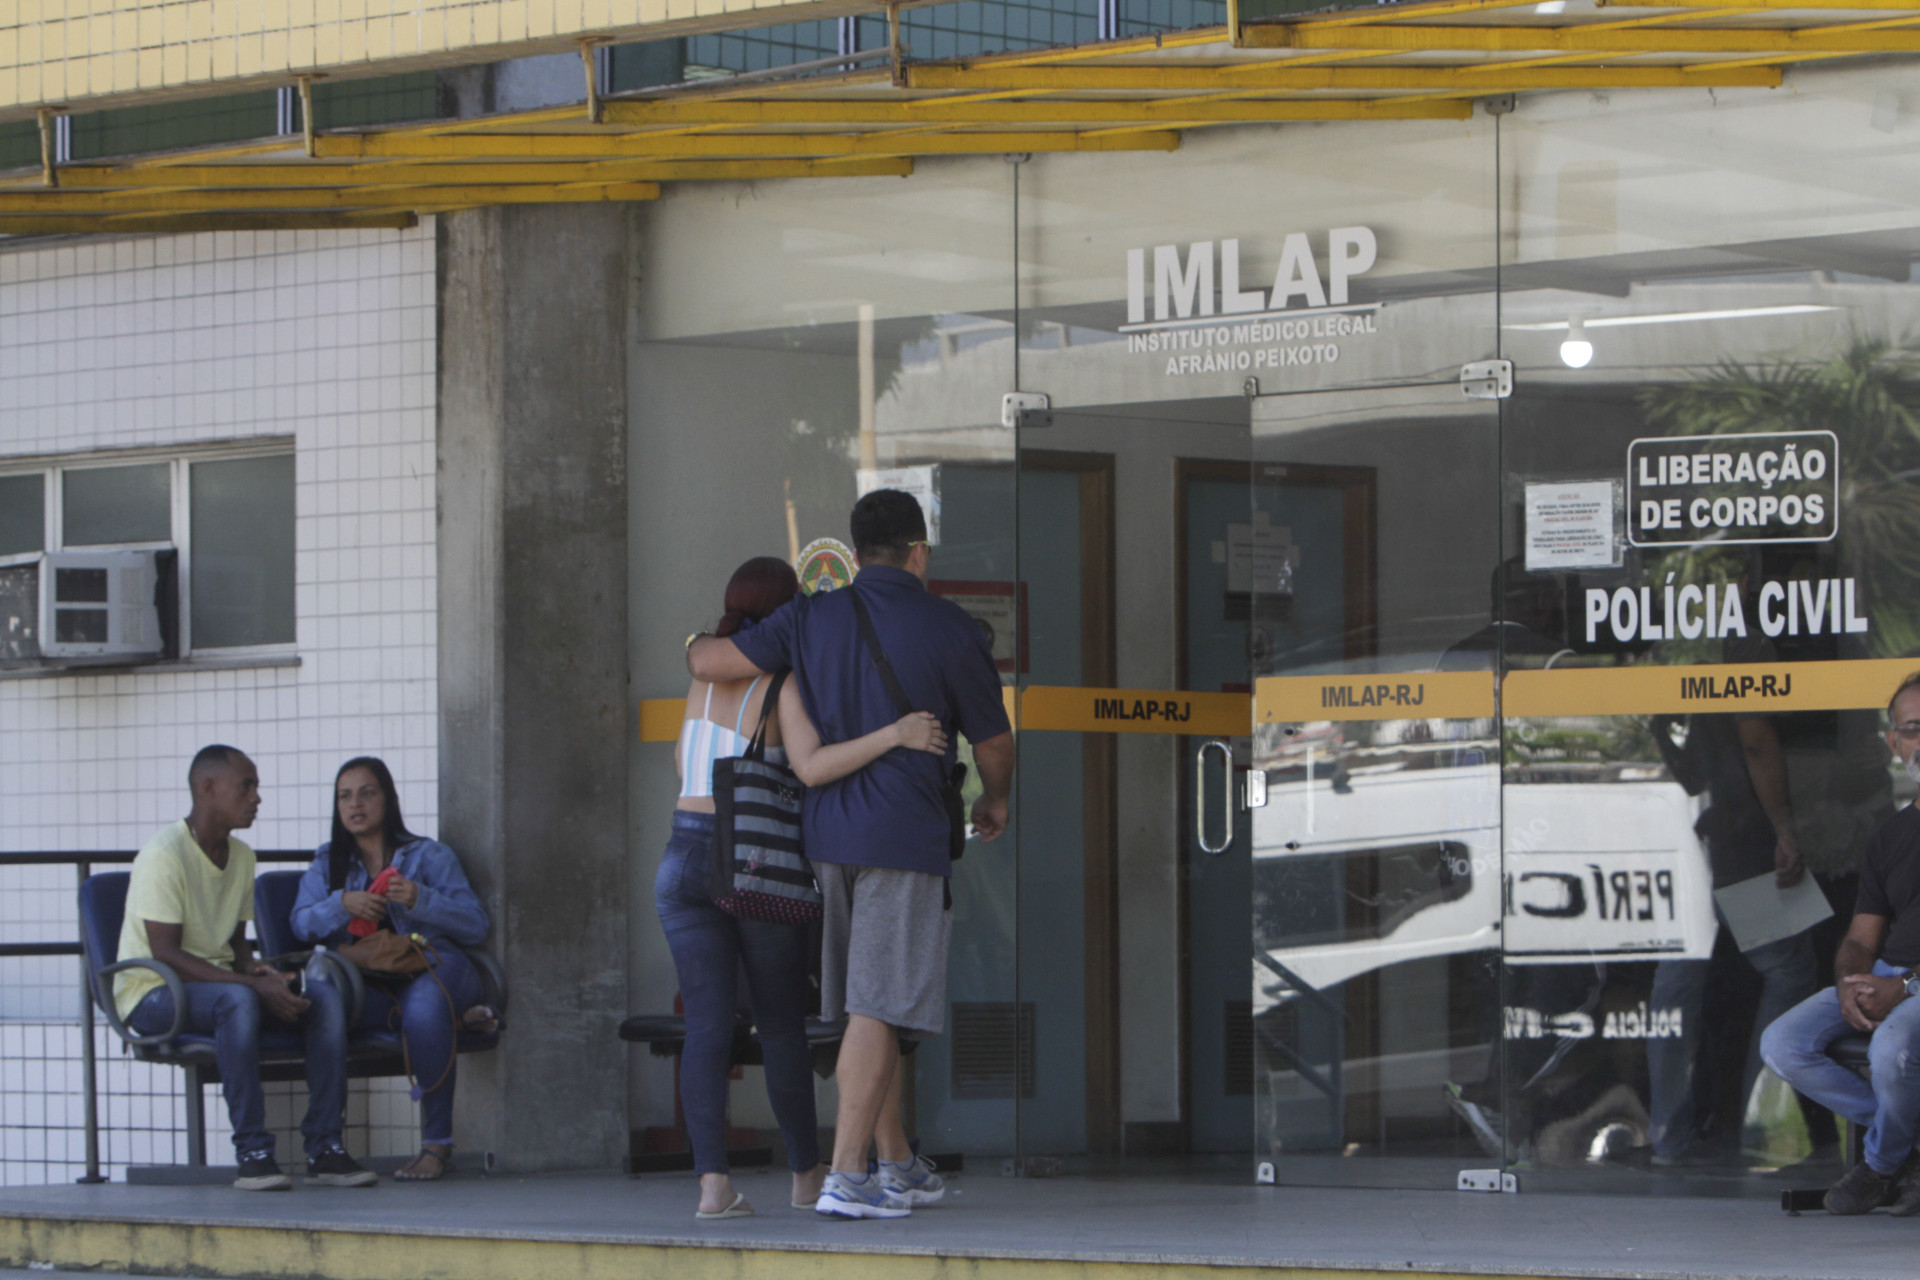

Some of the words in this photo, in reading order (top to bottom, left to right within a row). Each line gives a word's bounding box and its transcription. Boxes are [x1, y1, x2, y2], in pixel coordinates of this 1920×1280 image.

[1127, 225, 1378, 323] IMLAP
[1127, 326, 1231, 354] INSTITUTO
[1233, 319, 1310, 345] MÉDICO
[1313, 314, 1377, 338] LEGAL
[1165, 350, 1250, 376] AFRÂNIO
[1254, 343, 1340, 369] PEIXOTO
[1639, 443, 1826, 490] LIBERAÇÃO
[1640, 498, 1682, 530] DE
[1689, 493, 1825, 528] CORPOS
[1585, 571, 1747, 643] POLÍCIA
[1758, 577, 1868, 638] CIVIL
[1321, 683, 1425, 708] IMLAP-RJ
[1681, 673, 1791, 700] IMLAP-RJ
[1094, 698, 1191, 723] IMLAP-RJ
